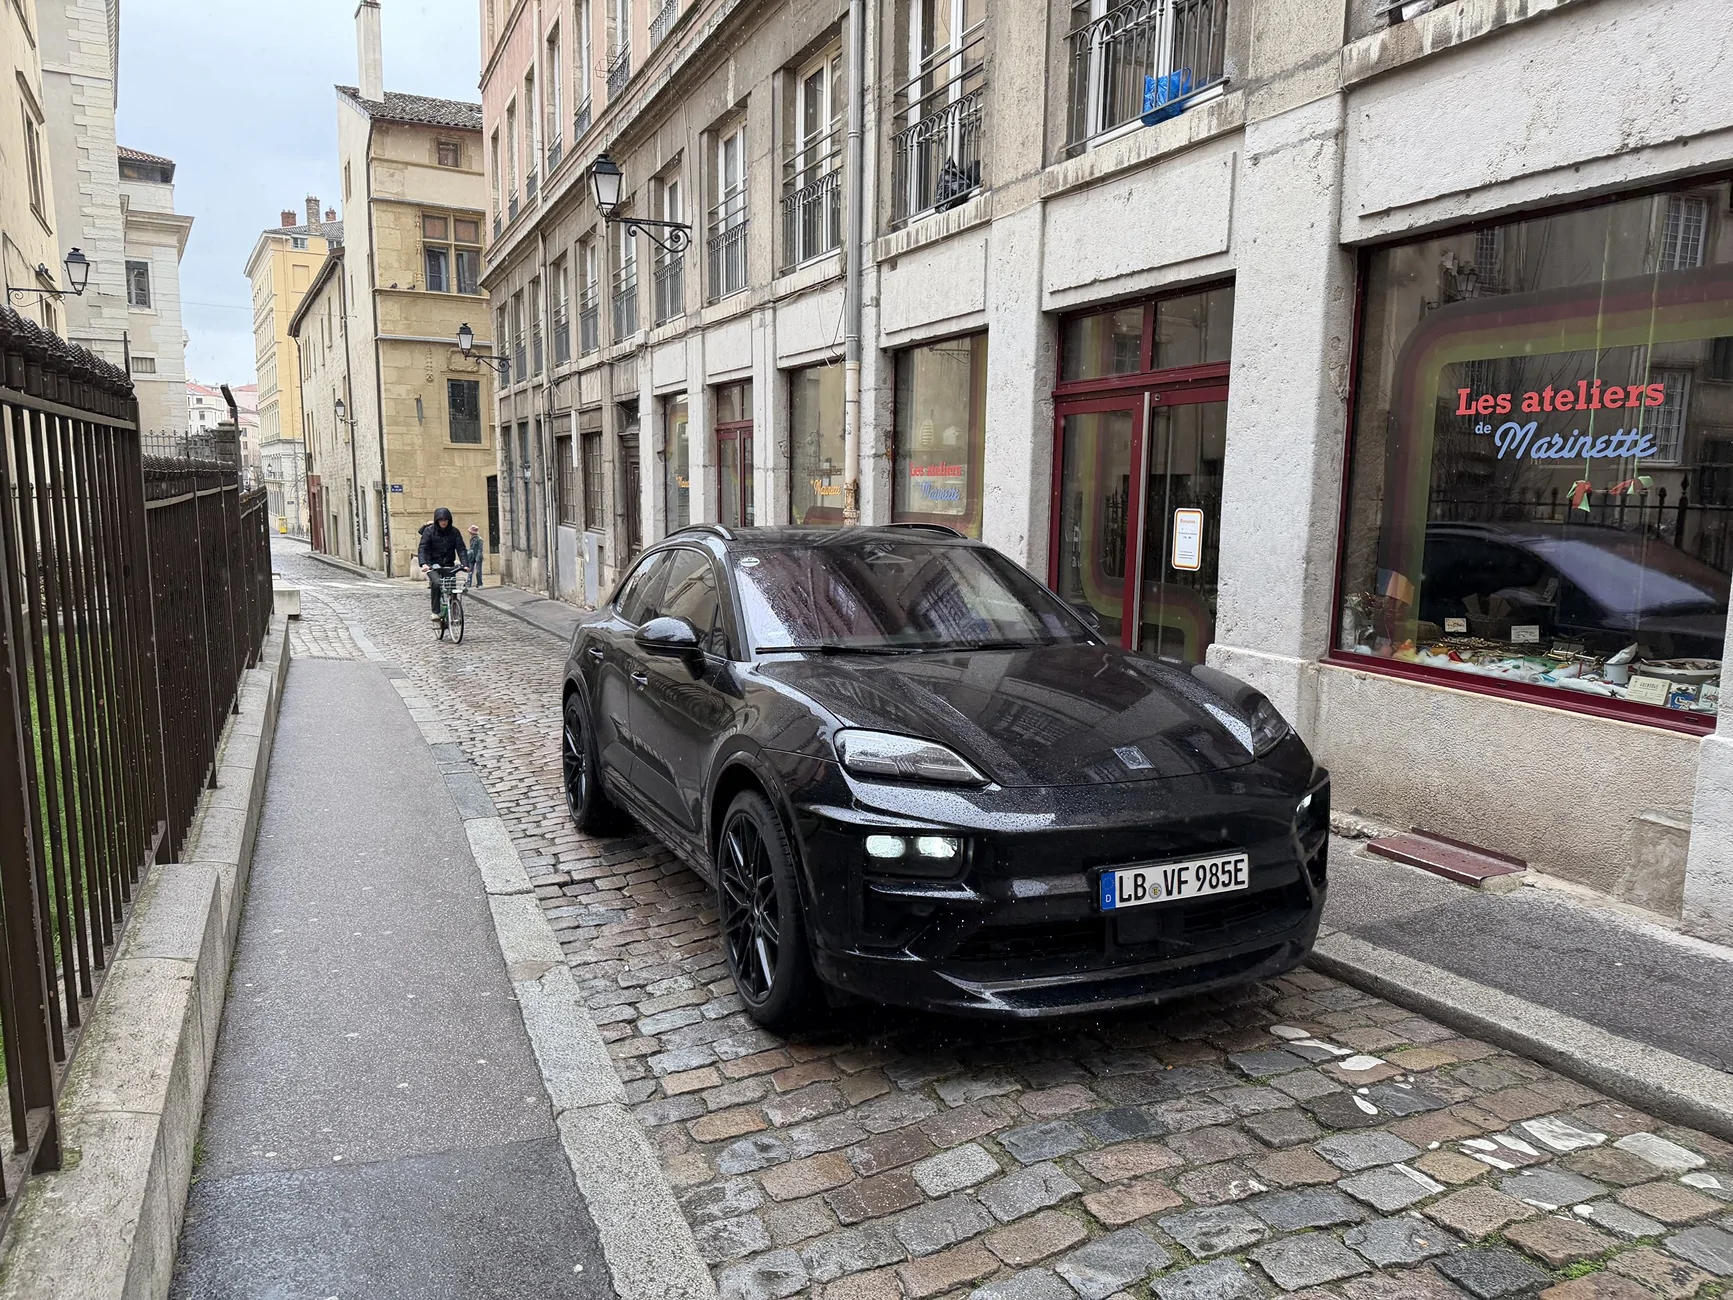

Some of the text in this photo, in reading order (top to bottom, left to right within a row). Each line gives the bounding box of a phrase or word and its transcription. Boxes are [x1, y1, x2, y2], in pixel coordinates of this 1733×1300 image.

[1456, 379, 1665, 415] Les ateliers
[1474, 421, 1658, 460] de Marinette
[1105, 858, 1246, 903] D LB VF 985E
